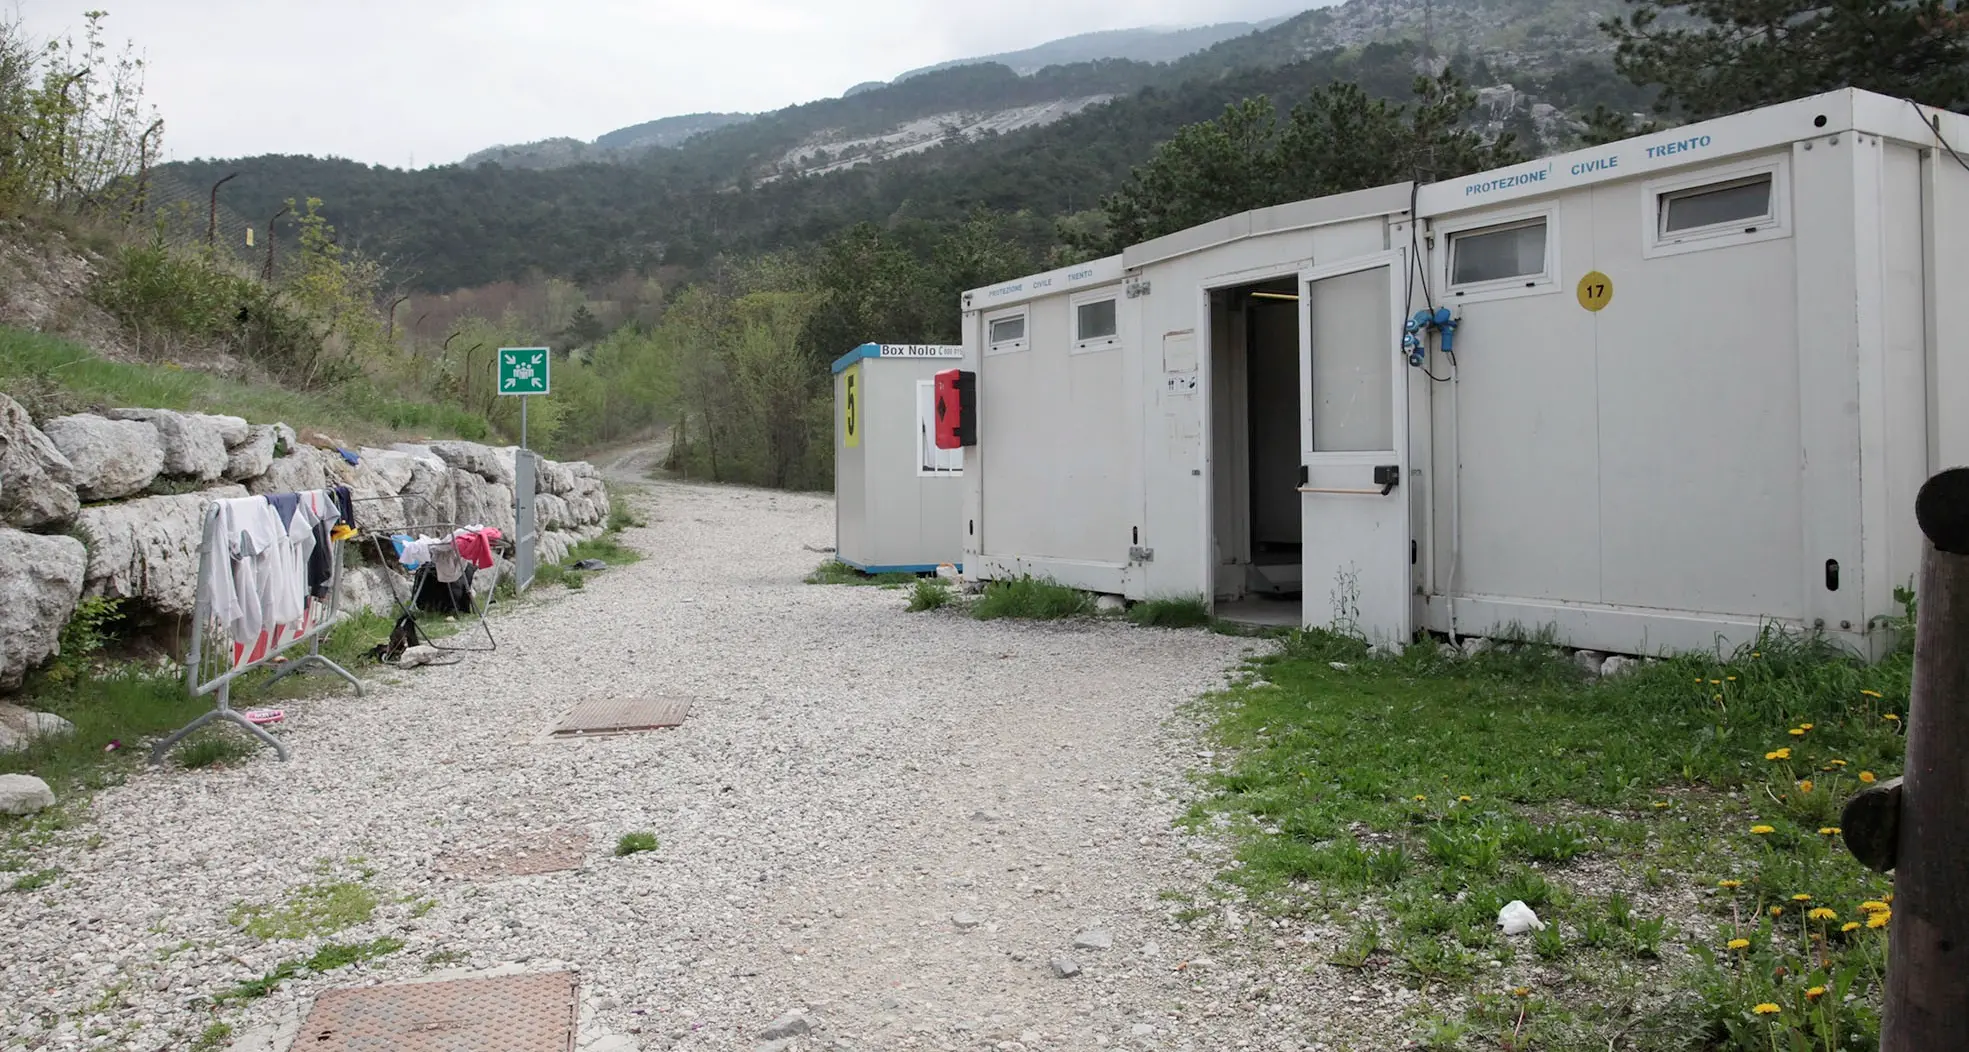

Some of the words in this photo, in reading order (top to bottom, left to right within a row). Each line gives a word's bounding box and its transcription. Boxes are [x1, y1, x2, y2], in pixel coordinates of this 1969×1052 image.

[1465, 169, 1547, 196] PROTEZIONE
[1571, 156, 1618, 176] CIVILE
[1646, 135, 1711, 159] TRENTO
[988, 284, 1023, 297] PROTEZIONE
[1032, 279, 1053, 289] CIVILE
[1068, 270, 1093, 281] TRENTO
[1587, 285, 1604, 298] 17
[882, 345, 904, 356] Box
[908, 345, 936, 356] Nolo
[847, 375, 855, 436] 5
